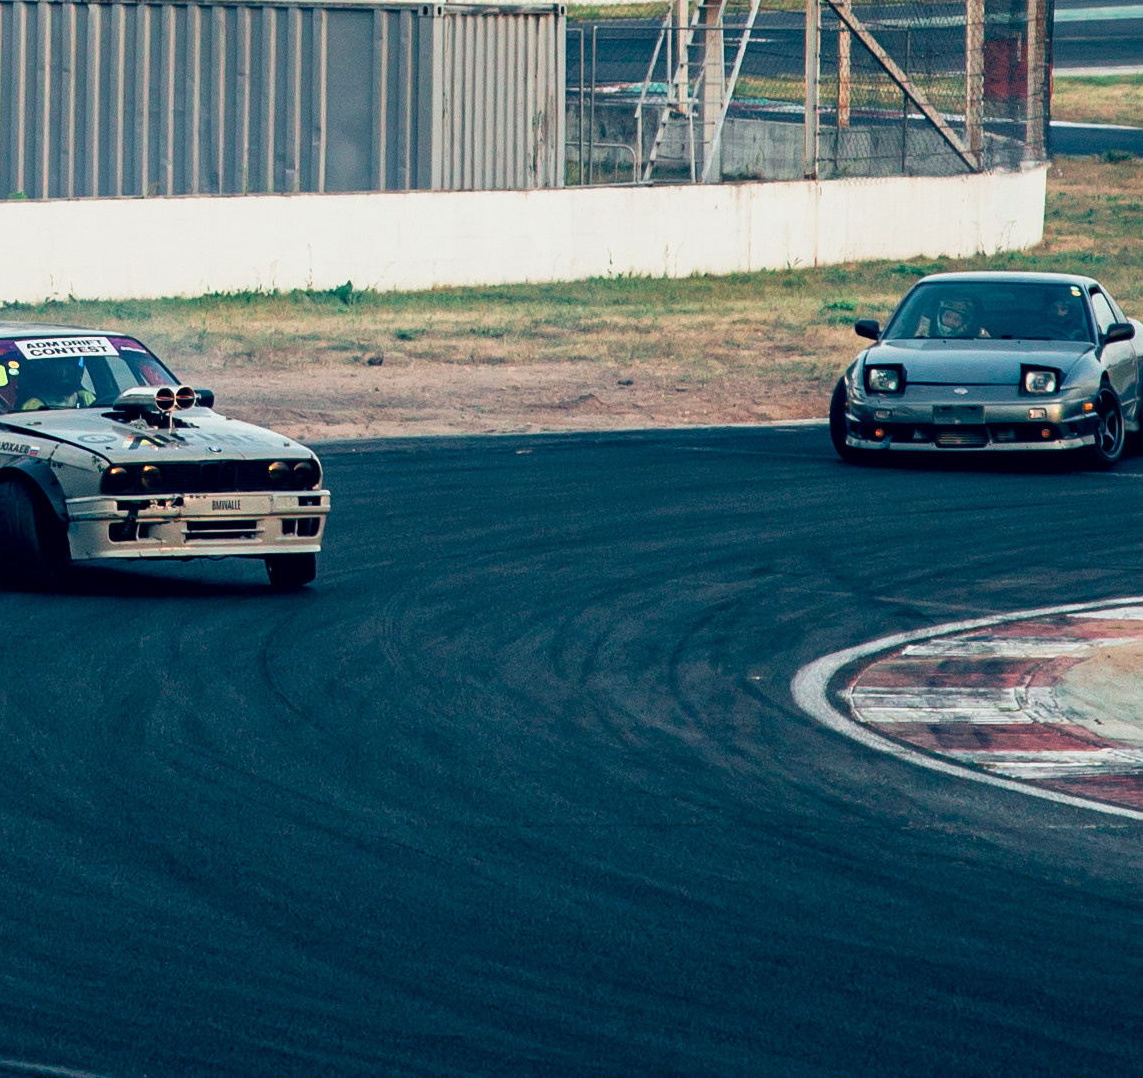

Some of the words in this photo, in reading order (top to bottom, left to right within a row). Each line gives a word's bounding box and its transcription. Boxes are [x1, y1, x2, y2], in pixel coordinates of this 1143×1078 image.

[26, 341, 60, 350] ADM
[61, 339, 103, 347] DRIFT
[29, 345, 108, 357] CONTEST
